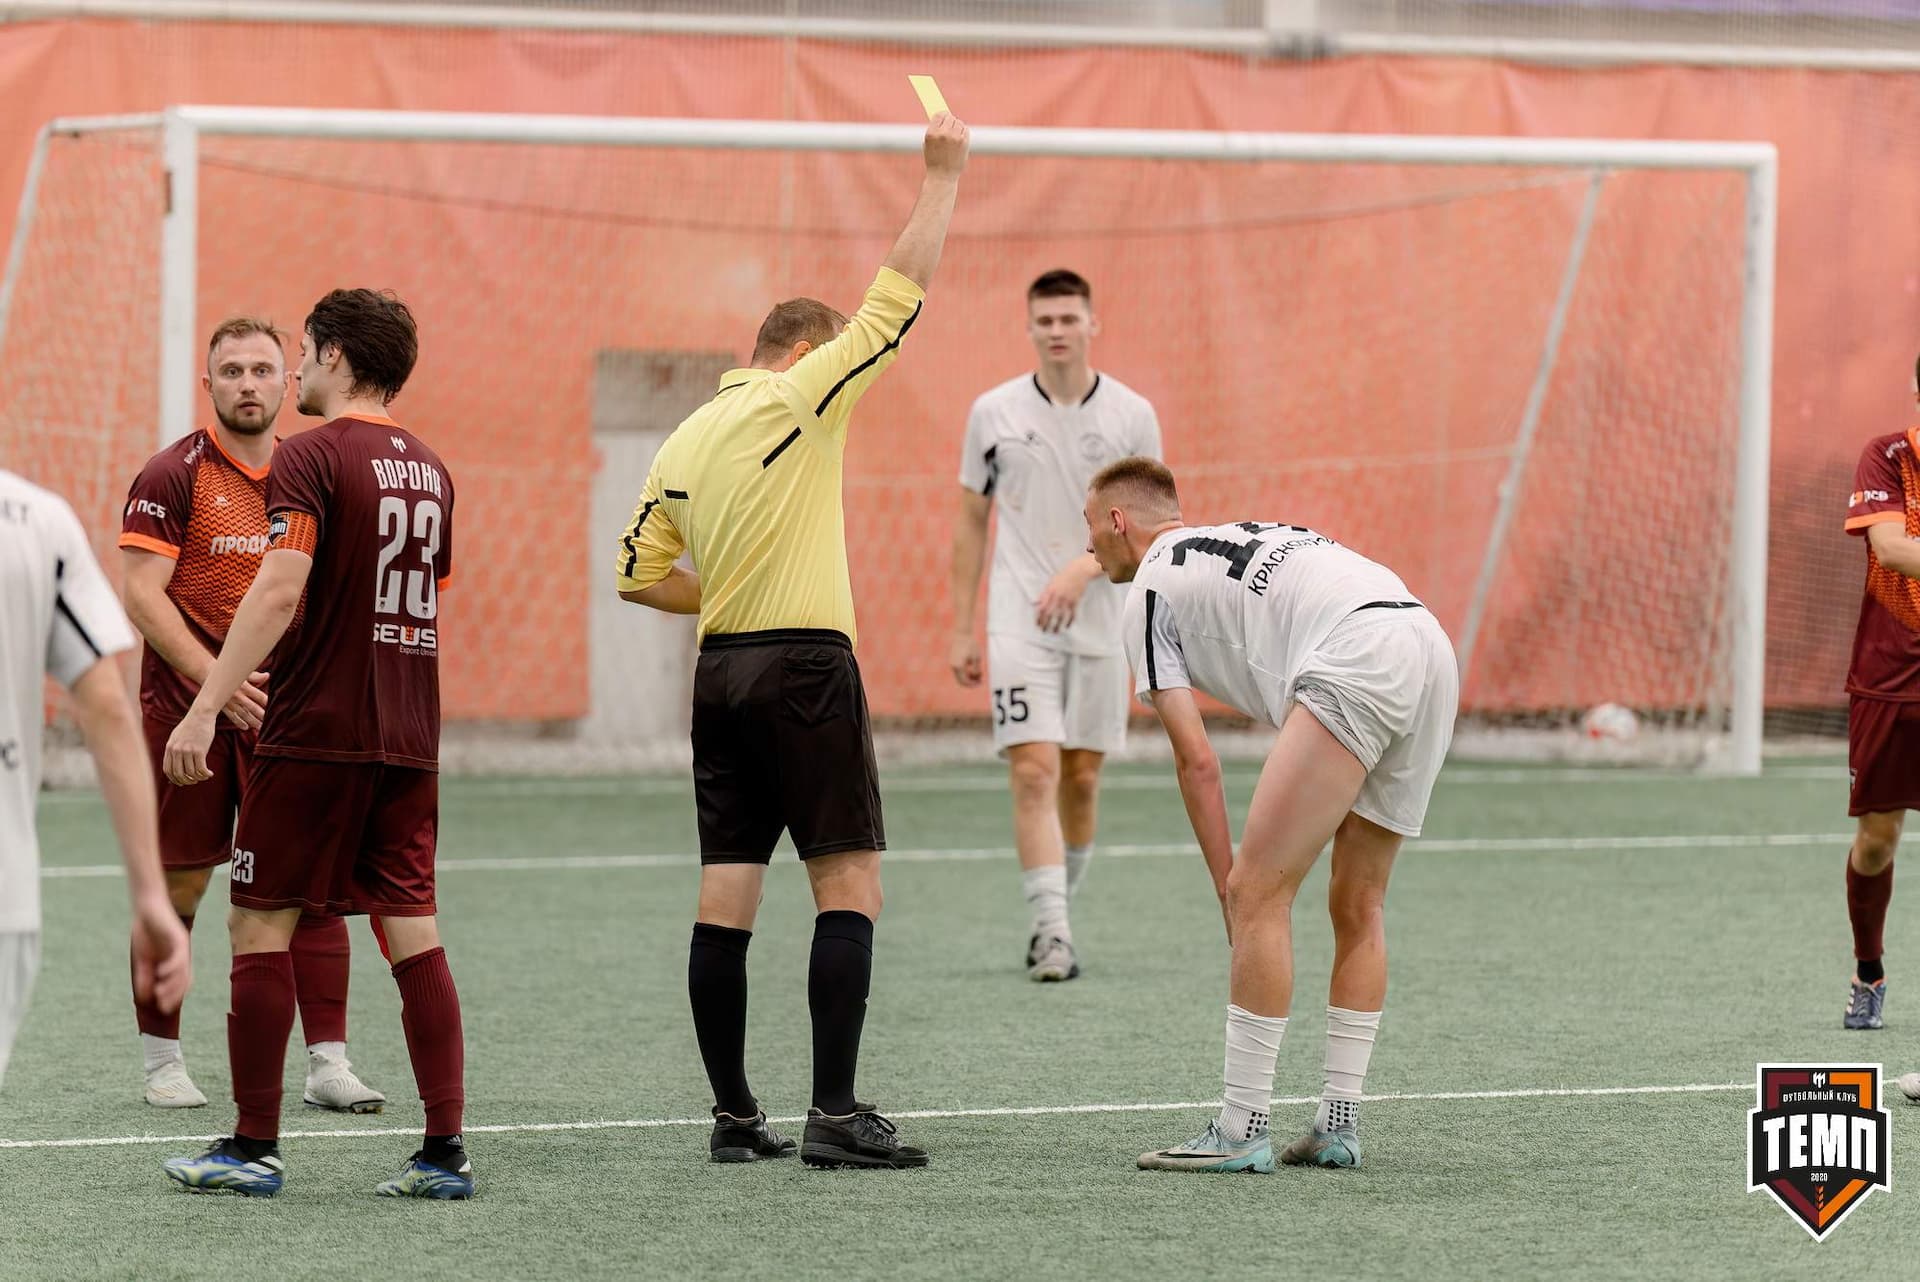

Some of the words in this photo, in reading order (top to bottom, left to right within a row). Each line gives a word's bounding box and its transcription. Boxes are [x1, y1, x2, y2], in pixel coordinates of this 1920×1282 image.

[370, 458, 442, 500] ВОРОНА
[136, 499, 166, 519] ПСБ
[374, 495, 442, 620] 23
[231, 847, 255, 884] 23
